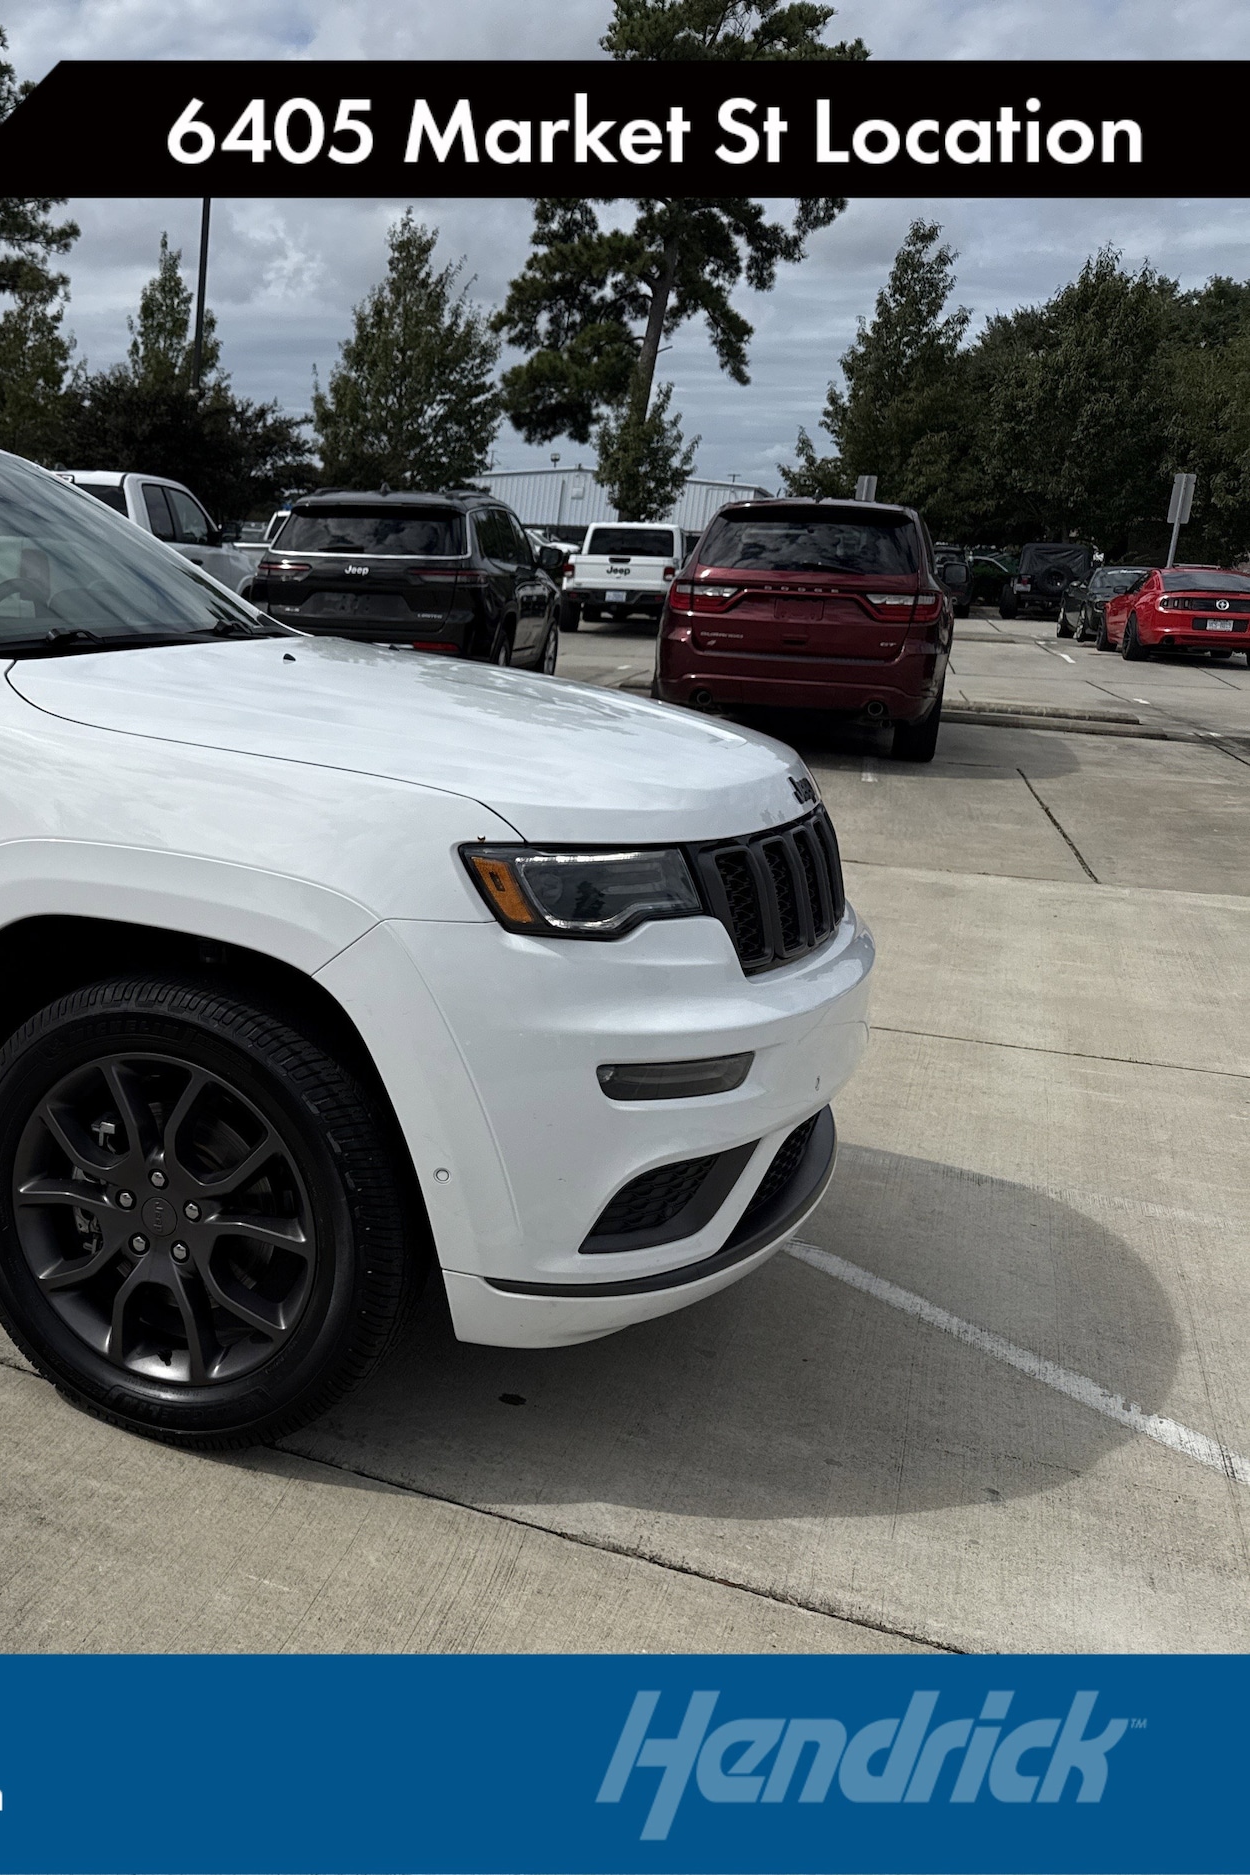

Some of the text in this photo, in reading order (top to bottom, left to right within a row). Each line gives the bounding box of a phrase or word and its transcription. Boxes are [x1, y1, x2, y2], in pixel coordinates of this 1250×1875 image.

[344, 565, 369, 576] Jeep
[606, 565, 631, 576] Jeep
[763, 585, 840, 594] DODGE
[700, 630, 744, 640] DURANGO
